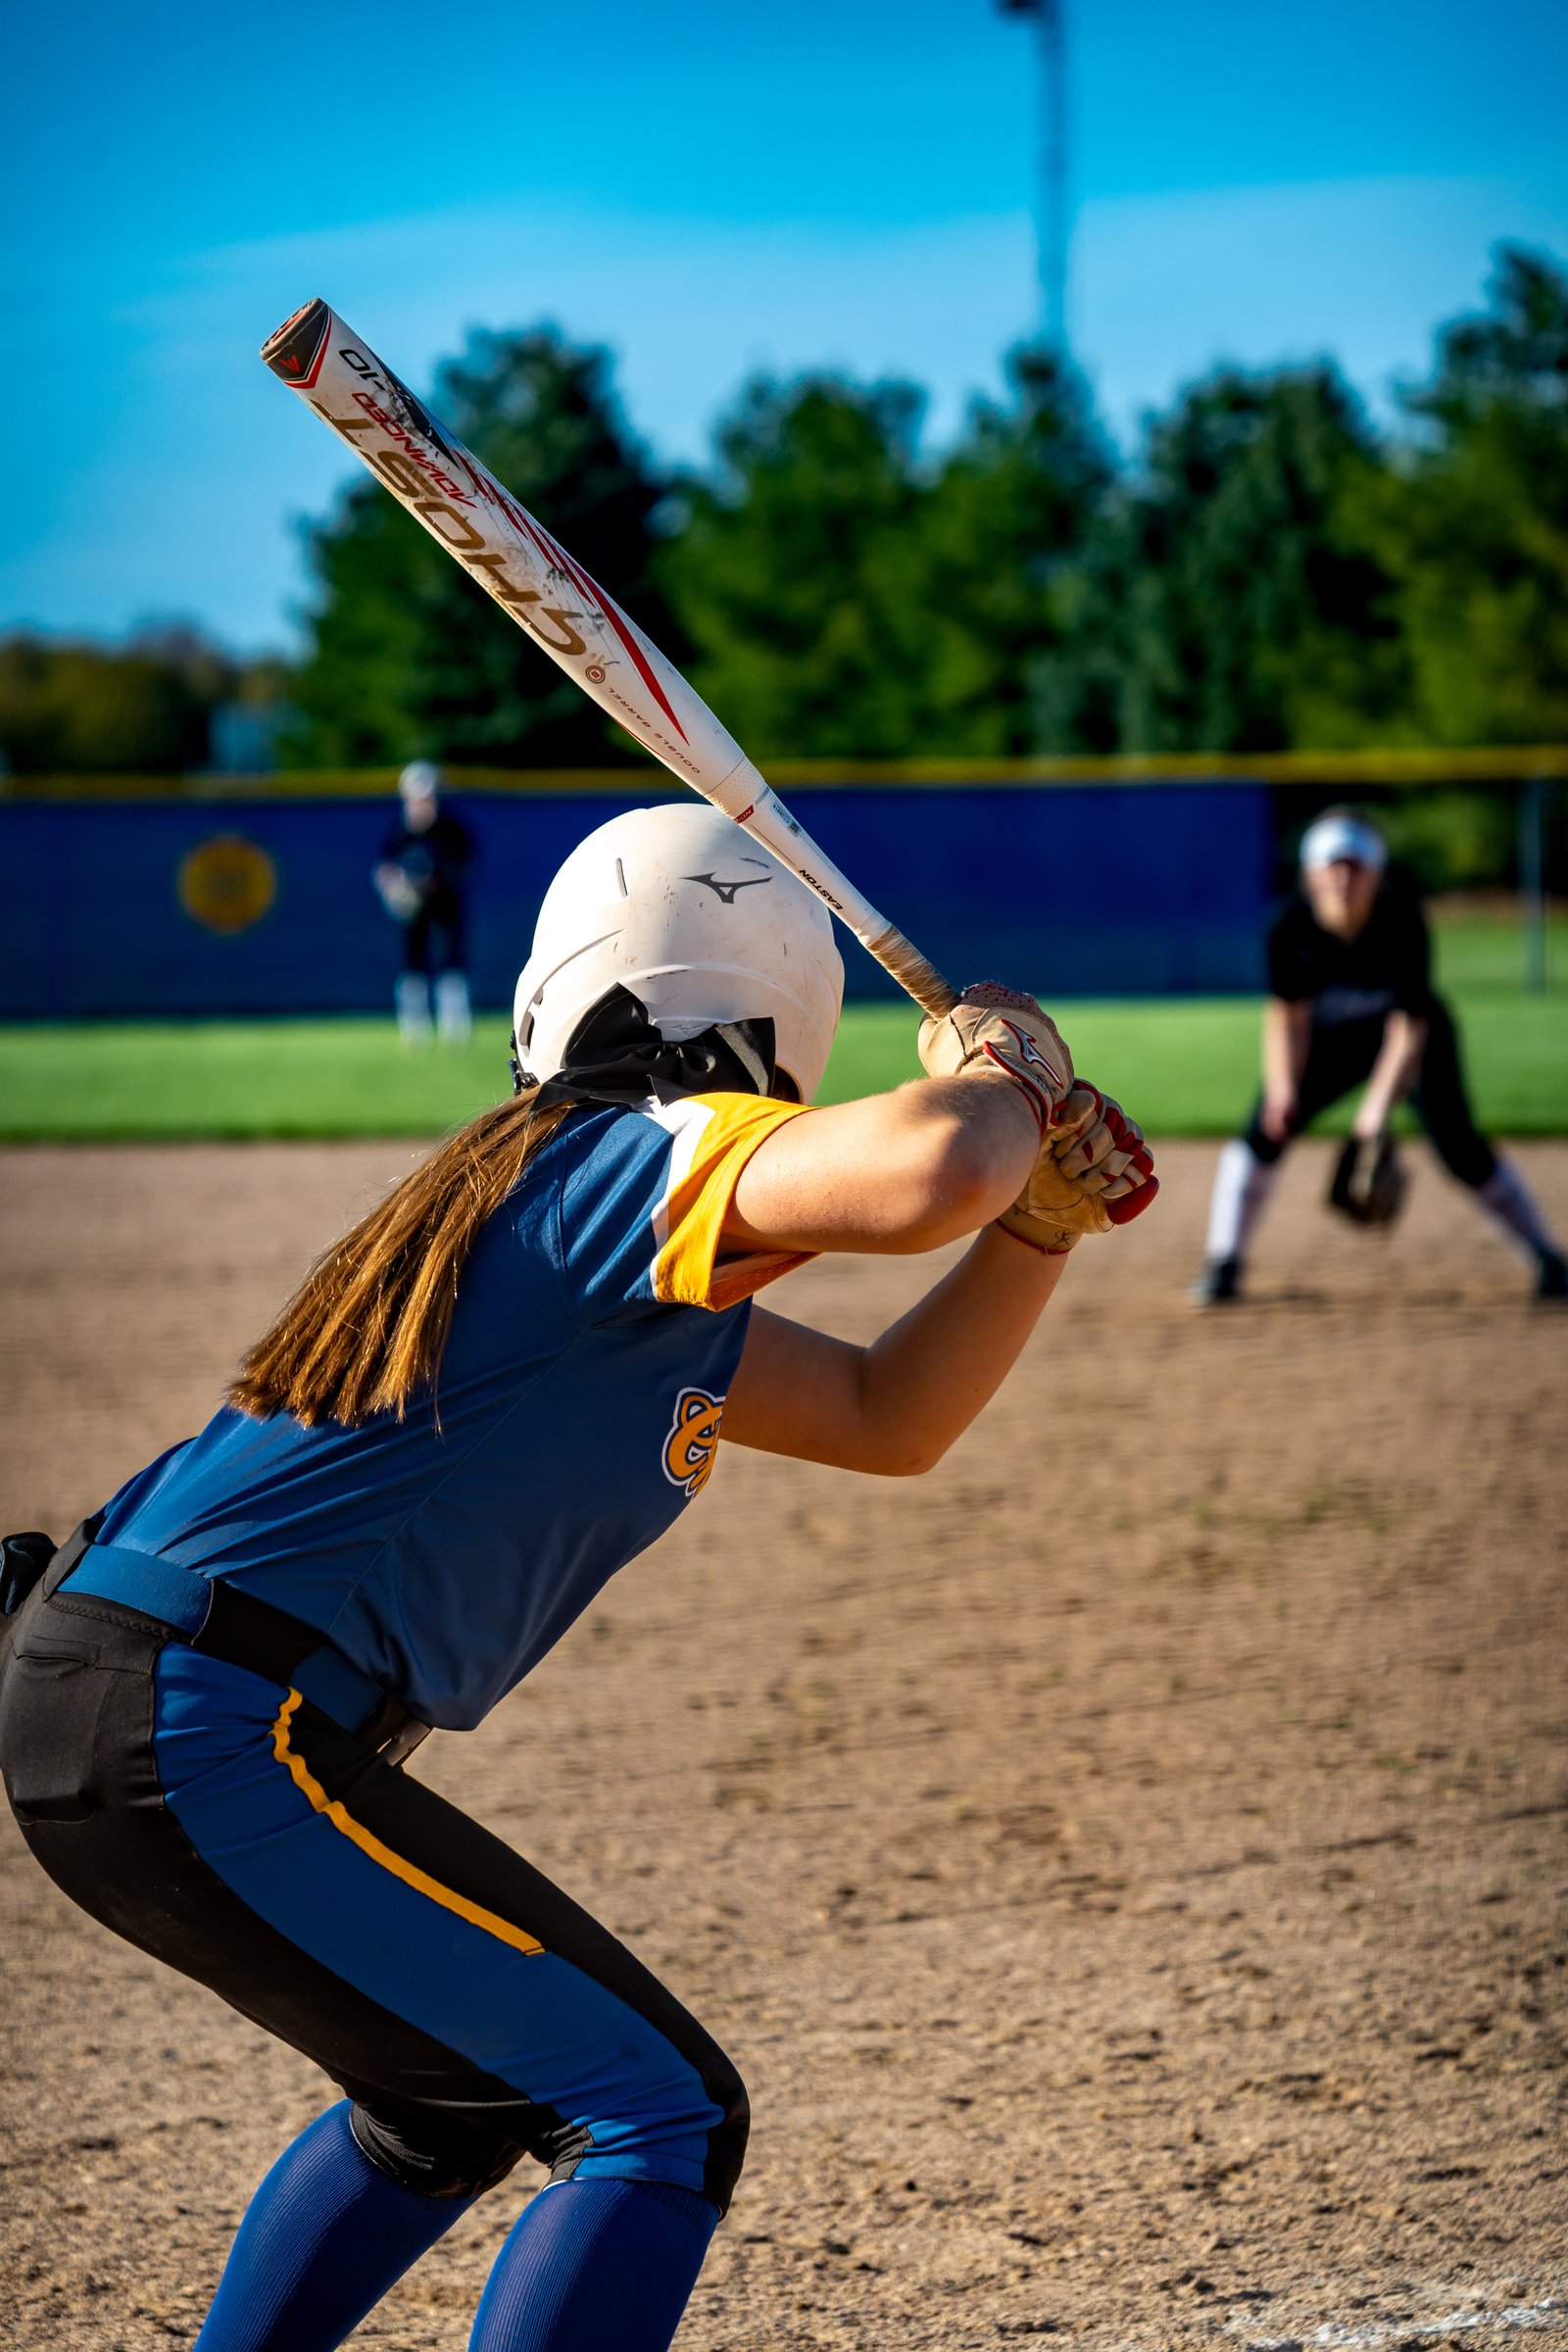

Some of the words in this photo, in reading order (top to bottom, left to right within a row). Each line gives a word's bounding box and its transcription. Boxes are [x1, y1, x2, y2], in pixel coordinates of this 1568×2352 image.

[351, 392, 477, 509] ADVANCED
[309, 399, 587, 656] GHOST
[609, 687, 651, 727] BARREL
[654, 732, 701, 773] DOUBLE
[799, 869, 844, 910] EASTON
